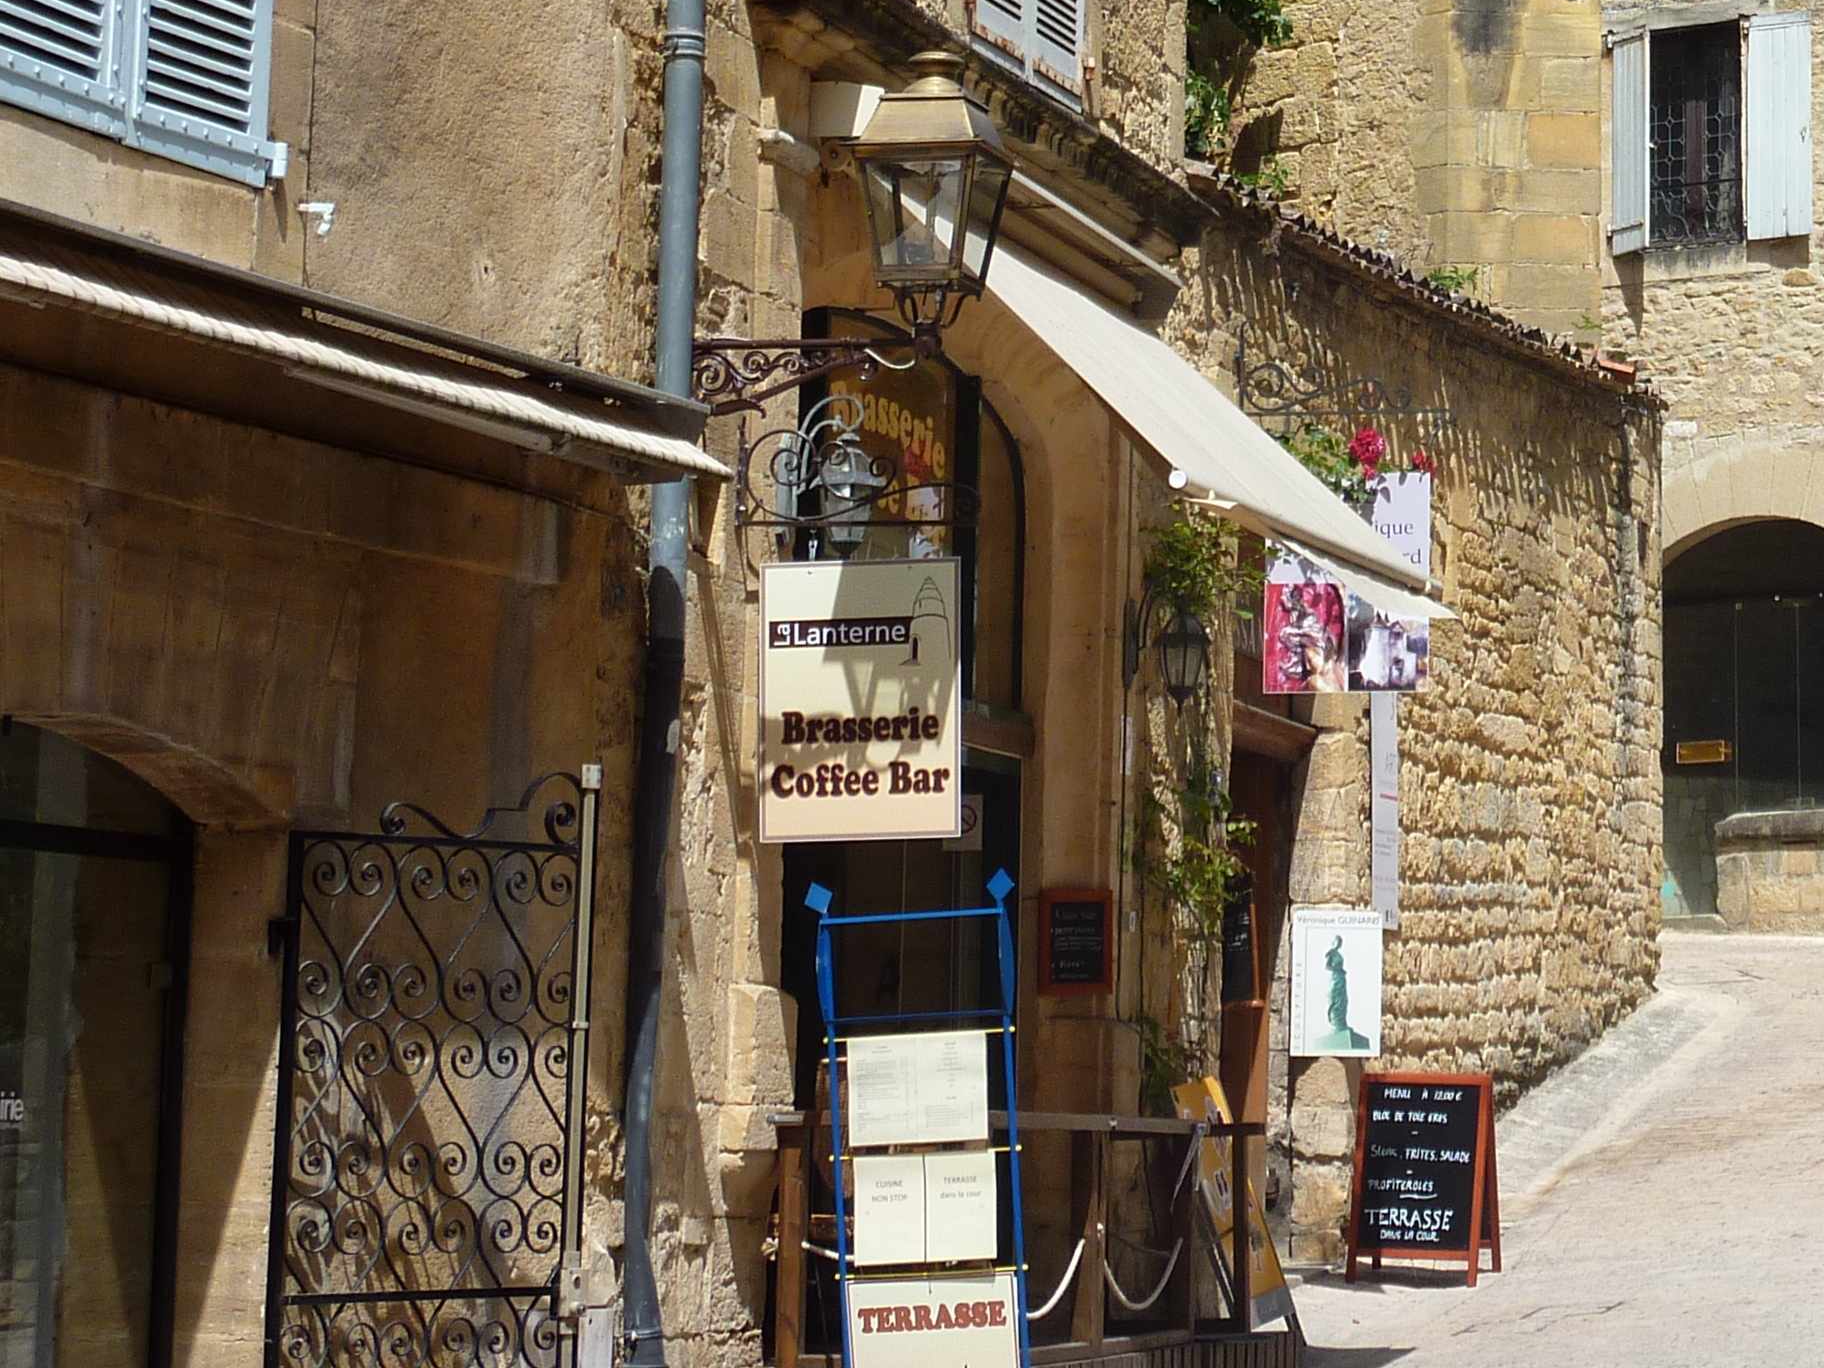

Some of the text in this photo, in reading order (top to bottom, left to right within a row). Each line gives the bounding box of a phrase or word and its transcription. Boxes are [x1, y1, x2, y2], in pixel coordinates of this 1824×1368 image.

[1375, 520, 1414, 539] ique
[773, 622, 906, 646] La Lanterne
[781, 706, 940, 745] Brasserie
[770, 761, 950, 799] Coffee Bar
[1337, 915, 1380, 925] GUINARD
[1384, 1088, 1411, 1100] MENU
[0, 1091, 25, 1121] irie
[1440, 1149, 1471, 1163] SALADE
[875, 1180, 903, 1189] CUISINE
[943, 1175, 978, 1185] TERRASSE
[1368, 1178, 1434, 1192] PROFITEROLES
[871, 1193, 908, 1203] NON STOP
[940, 1190, 982, 1200] dans la cour
[1364, 1208, 1454, 1231] TERRASSE
[1380, 1229, 1440, 1242] DANS LA COUR
[857, 1299, 1007, 1334] TERRASSE
